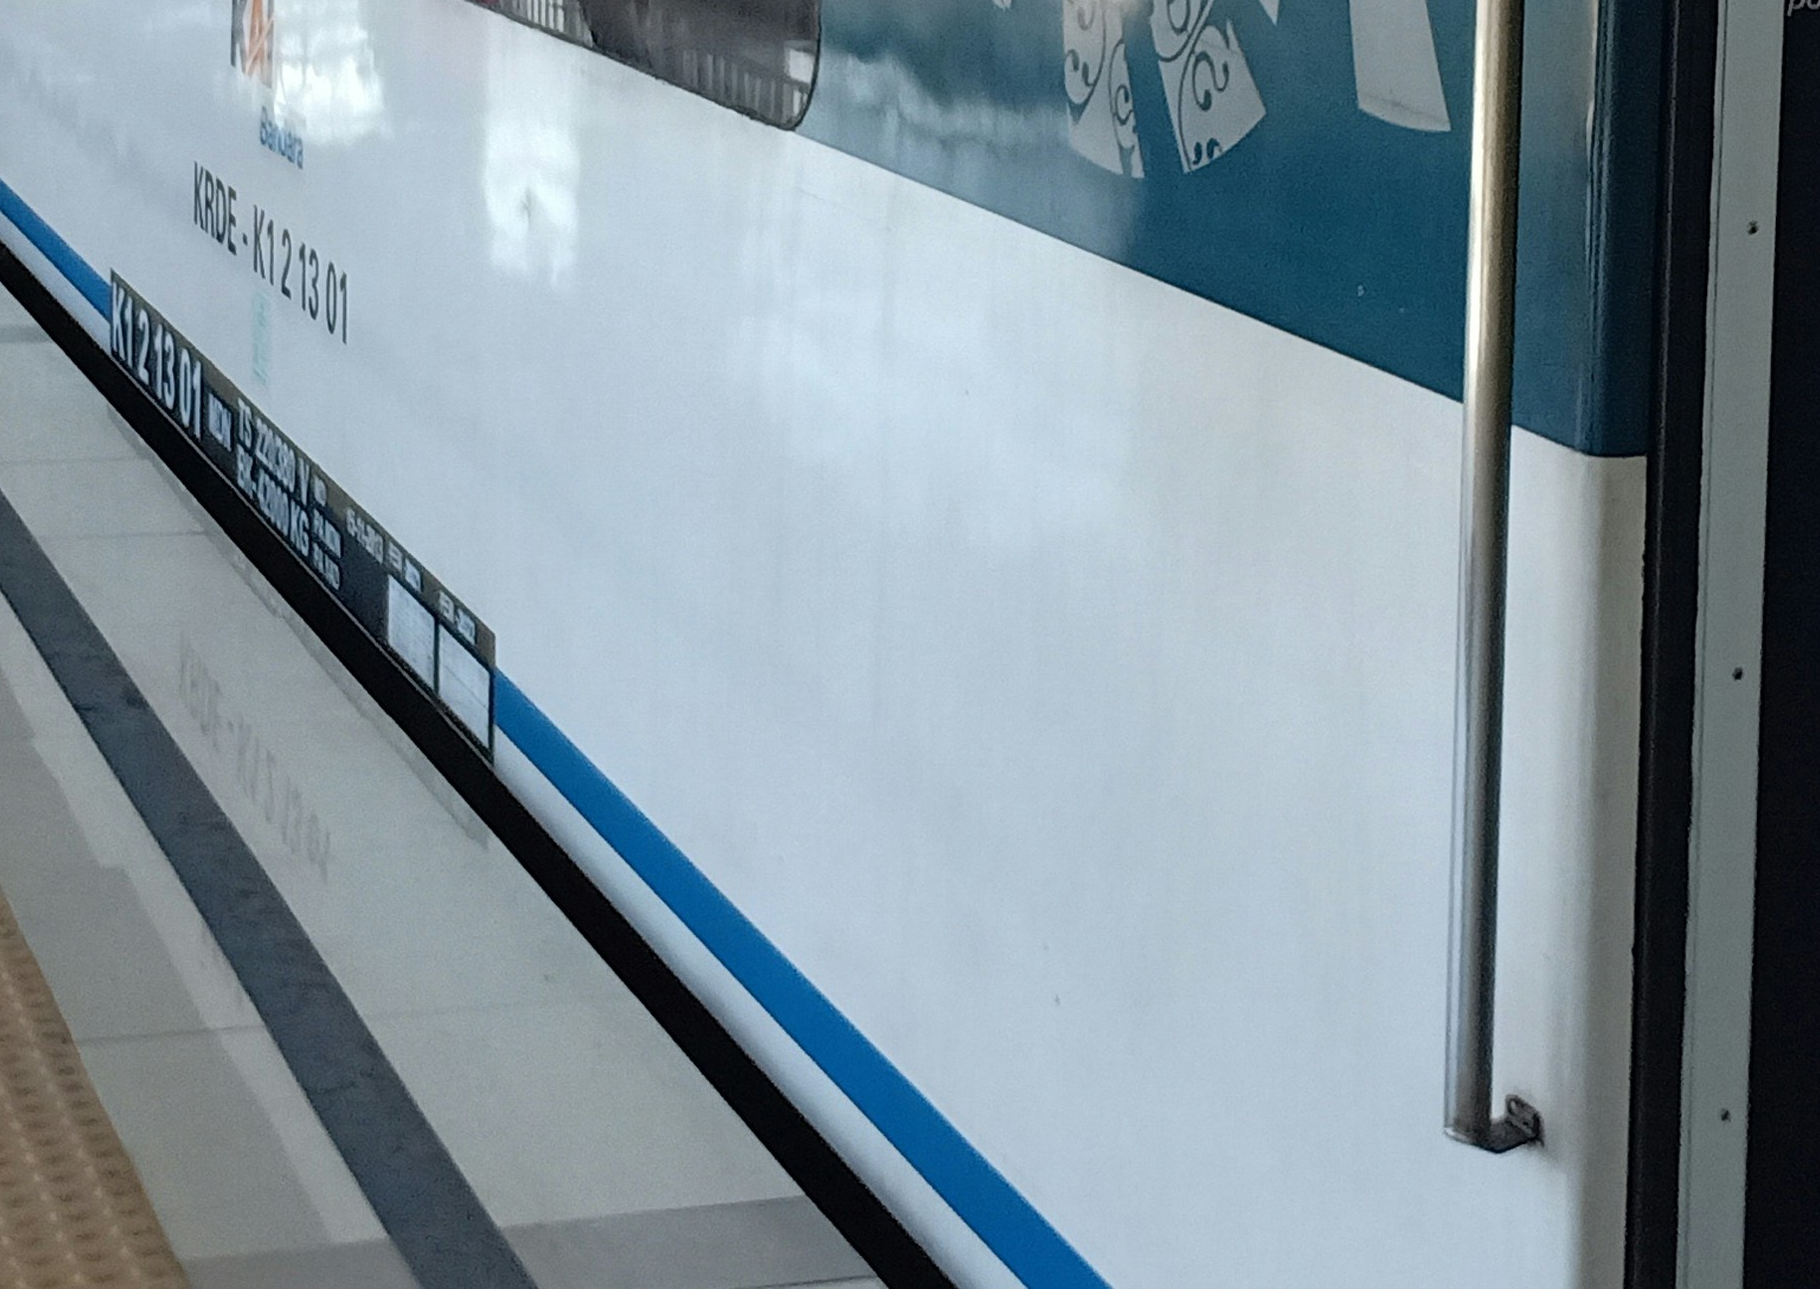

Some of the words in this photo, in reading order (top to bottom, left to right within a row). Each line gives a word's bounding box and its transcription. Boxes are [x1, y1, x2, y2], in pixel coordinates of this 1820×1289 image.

[193, 160, 237, 256] KRDE
[252, 204, 275, 287] K1
[280, 228, 292, 301] 2
[298, 241, 319, 321] 13
[325, 260, 348, 345] 01
[111, 280, 133, 369] K1
[137, 309, 150, 386] 2
[153, 323, 176, 410] 13
[179, 346, 202, 443] 01
[290, 498, 310, 558] KG
